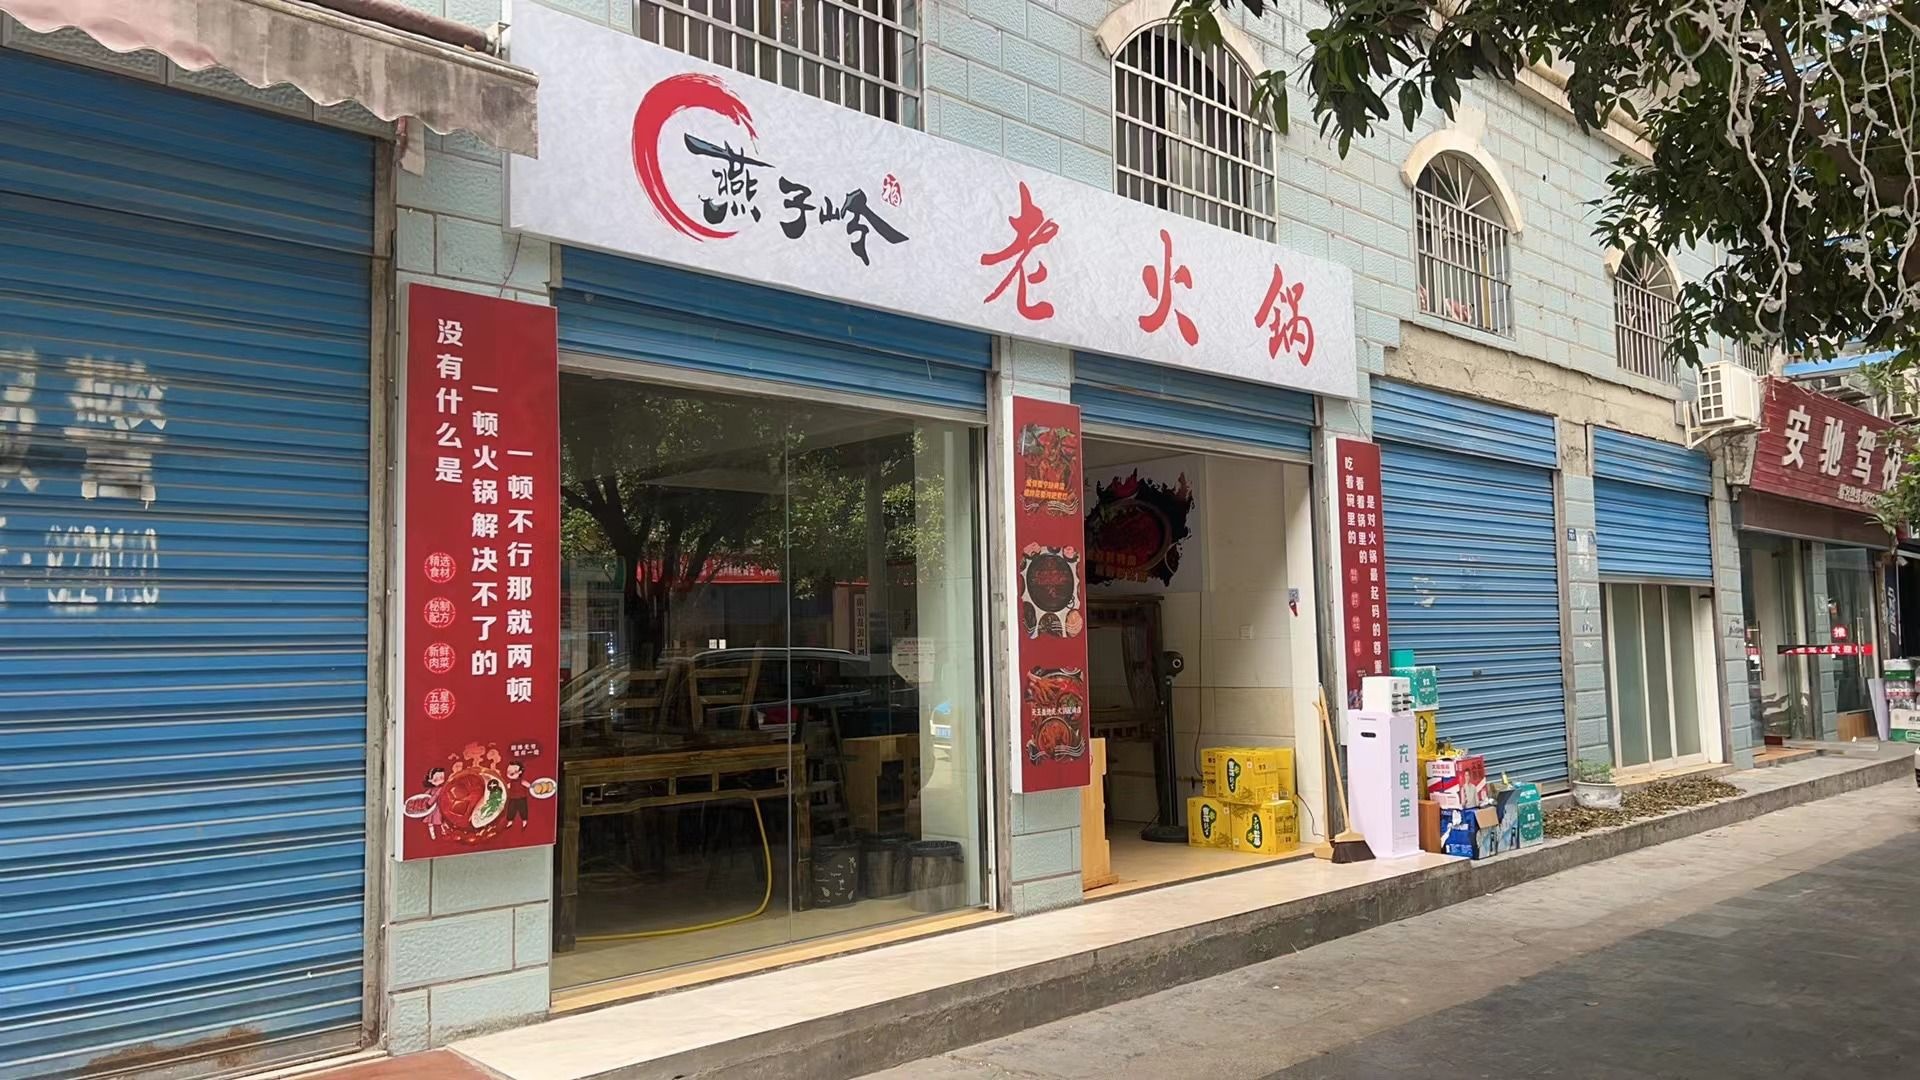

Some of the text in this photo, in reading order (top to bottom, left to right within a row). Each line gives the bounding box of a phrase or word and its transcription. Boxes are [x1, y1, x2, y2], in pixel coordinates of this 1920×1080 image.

[684, 133, 909, 266] 燕子岭
[980, 181, 1315, 366] 老火锅
[436, 318, 463, 483] 没有什么是
[472, 385, 498, 675] 一顿火锅解决不了的
[1344, 457, 1356, 544] 吃着碗里的
[1356, 477, 1368, 564] 看着锅里的
[429, 555, 450, 567] 精选
[430, 567, 450, 578] 食材
[507, 449, 533, 703] 一顿不行那就两顿
[1366, 495, 1382, 674] 是对火锅最起码的尊重
[429, 601, 450, 612] 秘制
[429, 612, 450, 623] 配方
[429, 646, 449, 656] 新鲜
[429, 657, 449, 668] 肉菜
[429, 703, 449, 714] 服务
[430, 692, 449, 702] 五星
[1398, 744, 1410, 818] 充电宝
